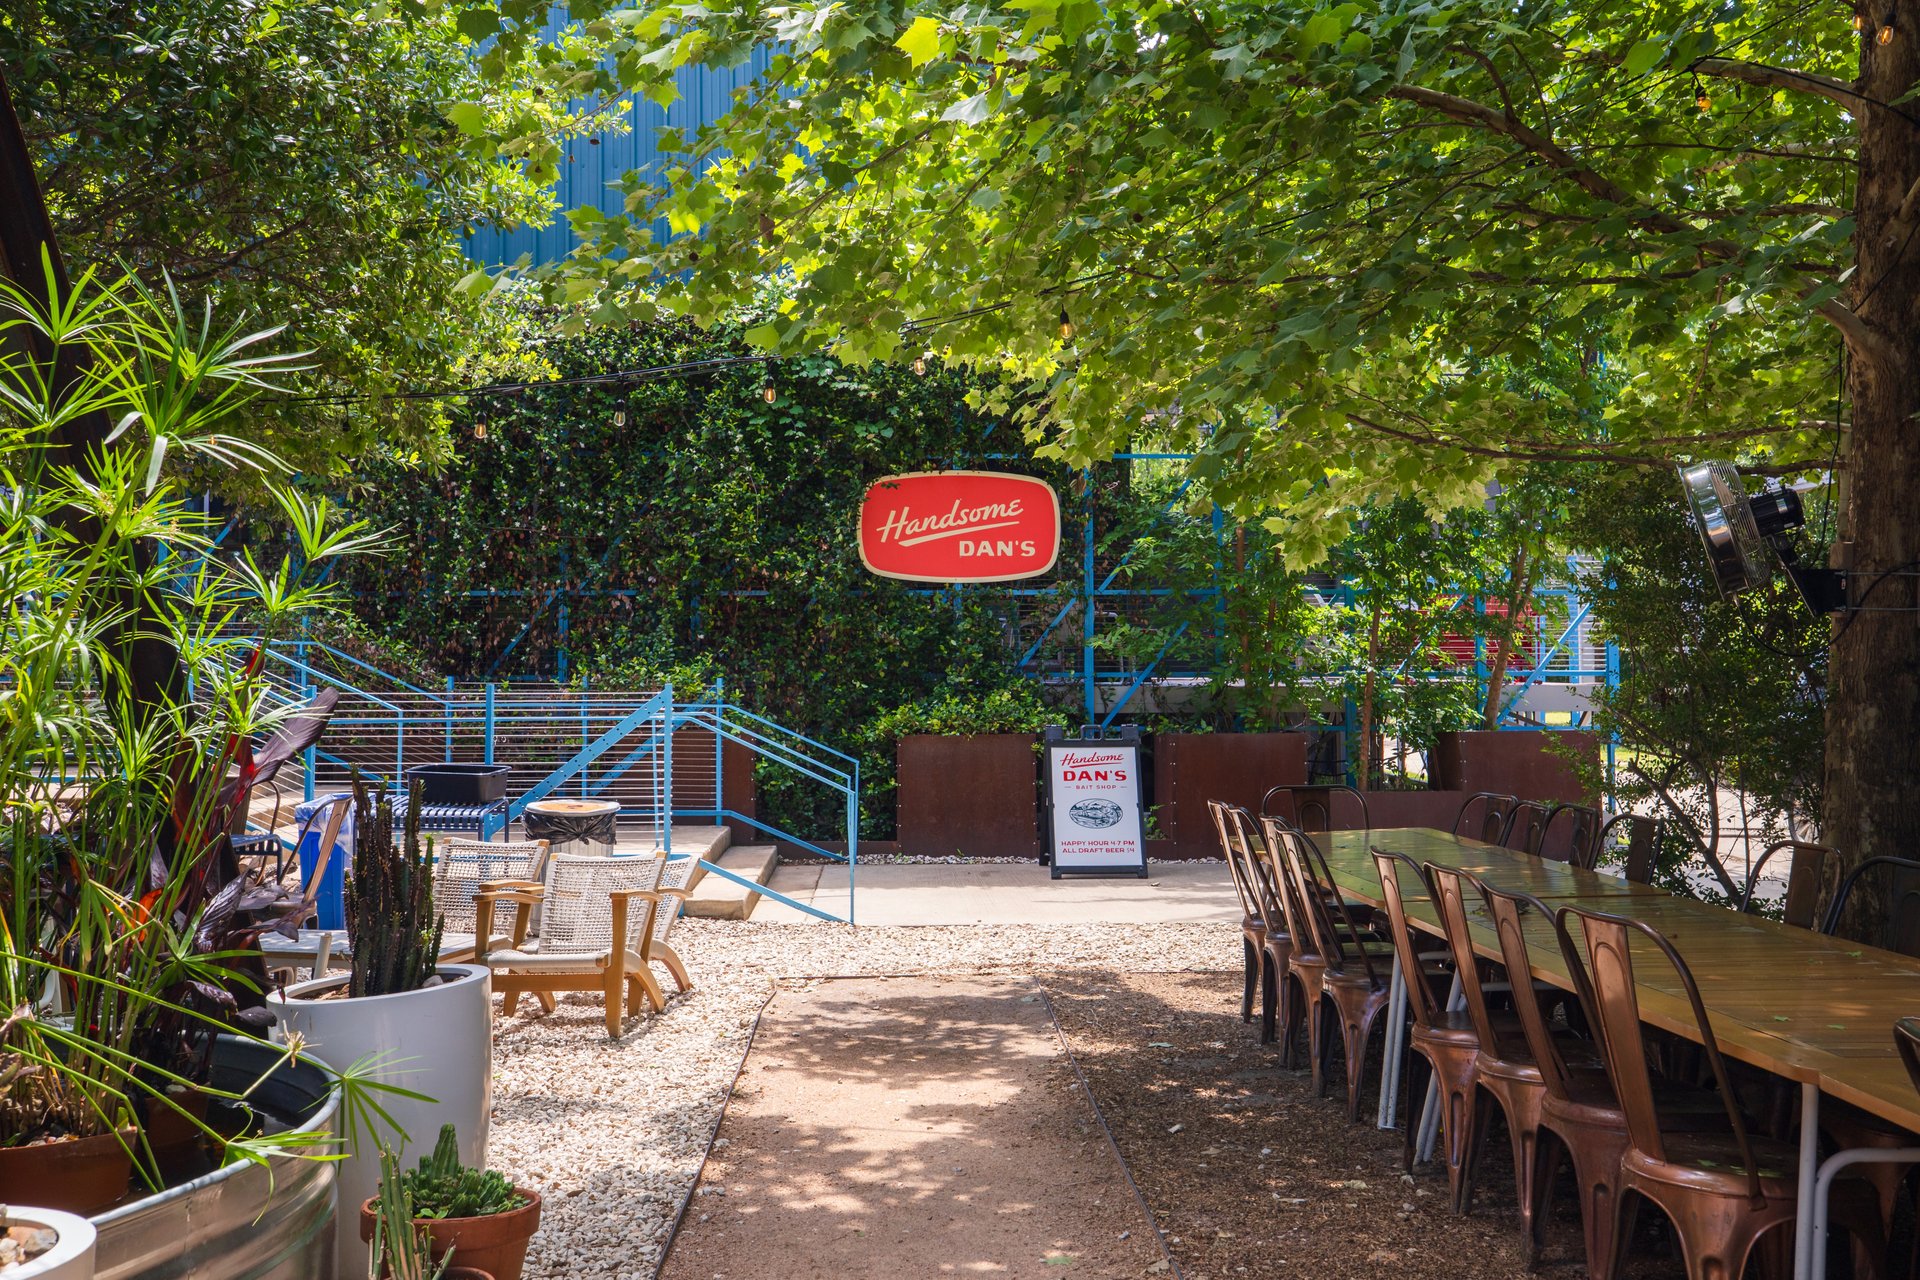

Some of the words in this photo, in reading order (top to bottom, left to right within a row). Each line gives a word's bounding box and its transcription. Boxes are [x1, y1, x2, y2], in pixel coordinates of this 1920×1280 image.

[876, 498, 1024, 543] Handsome
[959, 540, 1036, 557] DAN'S
[1060, 752, 1124, 766] Handsome
[1063, 770, 1127, 781] DAN'S
